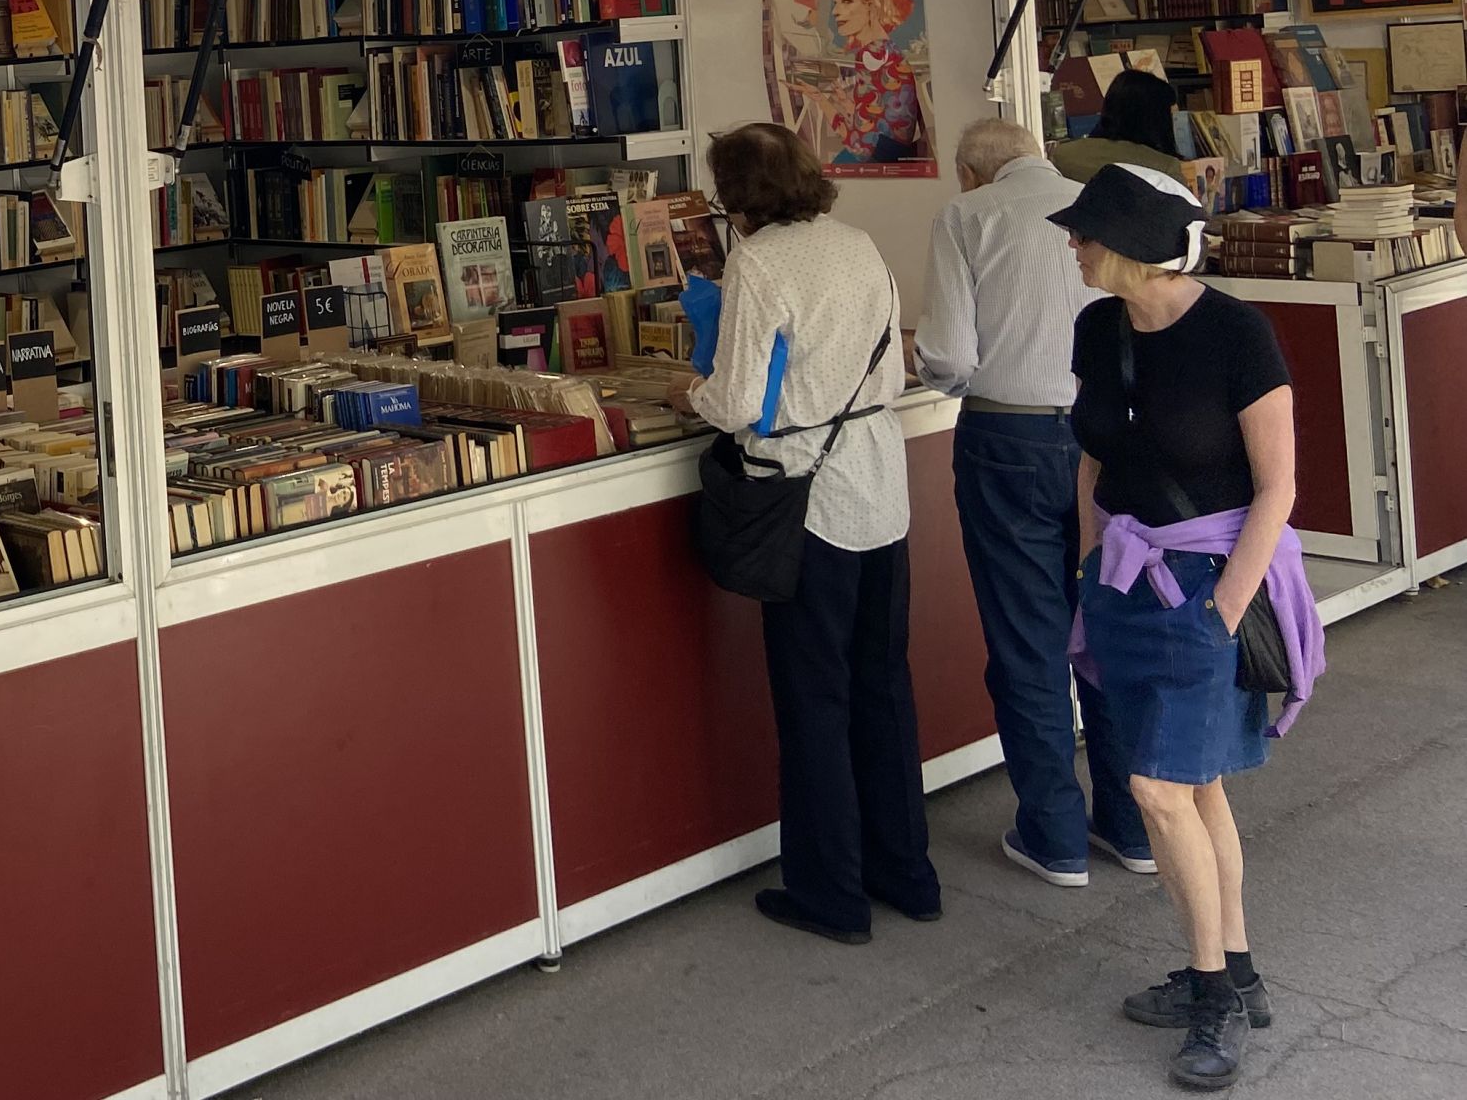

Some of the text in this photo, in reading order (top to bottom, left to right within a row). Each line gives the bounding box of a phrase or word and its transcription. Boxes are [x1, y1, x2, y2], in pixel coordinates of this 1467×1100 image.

[462, 47, 492, 61] ARTE
[604, 46, 643, 68] AZUL
[461, 158, 501, 172] CIENCIAS
[566, 202, 610, 214] SOBRE SEDA
[450, 226, 501, 242] CARPINTERIA
[452, 239, 502, 256] DECORATIVA
[266, 299, 296, 313] NOVELA
[315, 296, 334, 315] 5€
[269, 313, 294, 326] NEGRA
[183, 321, 219, 336] BIOGRAFÍAS
[12, 344, 53, 363] NARRATIVA
[380, 401, 412, 414] MAHOMA
[387, 462, 395, 475] LA
